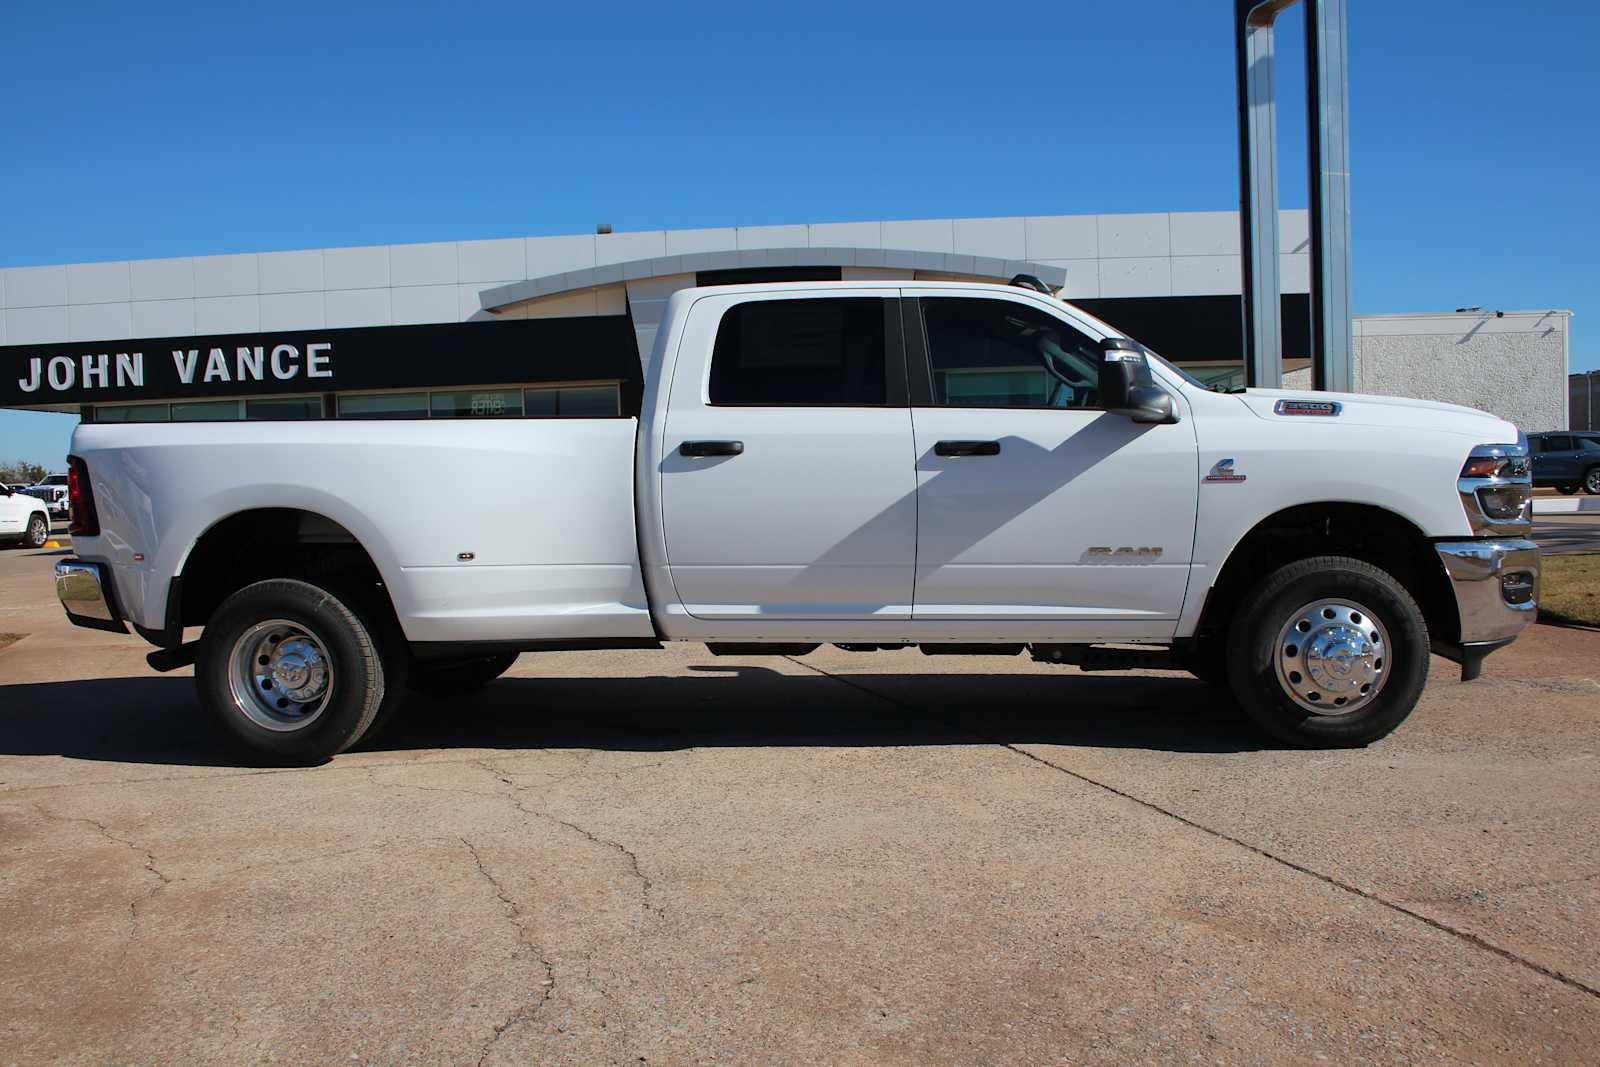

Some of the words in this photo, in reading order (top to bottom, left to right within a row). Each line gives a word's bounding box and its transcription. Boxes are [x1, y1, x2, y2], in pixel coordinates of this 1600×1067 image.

[18, 352, 144, 393] JOHN
[171, 342, 333, 384] VANCE
[1087, 546, 1163, 557] RAM
